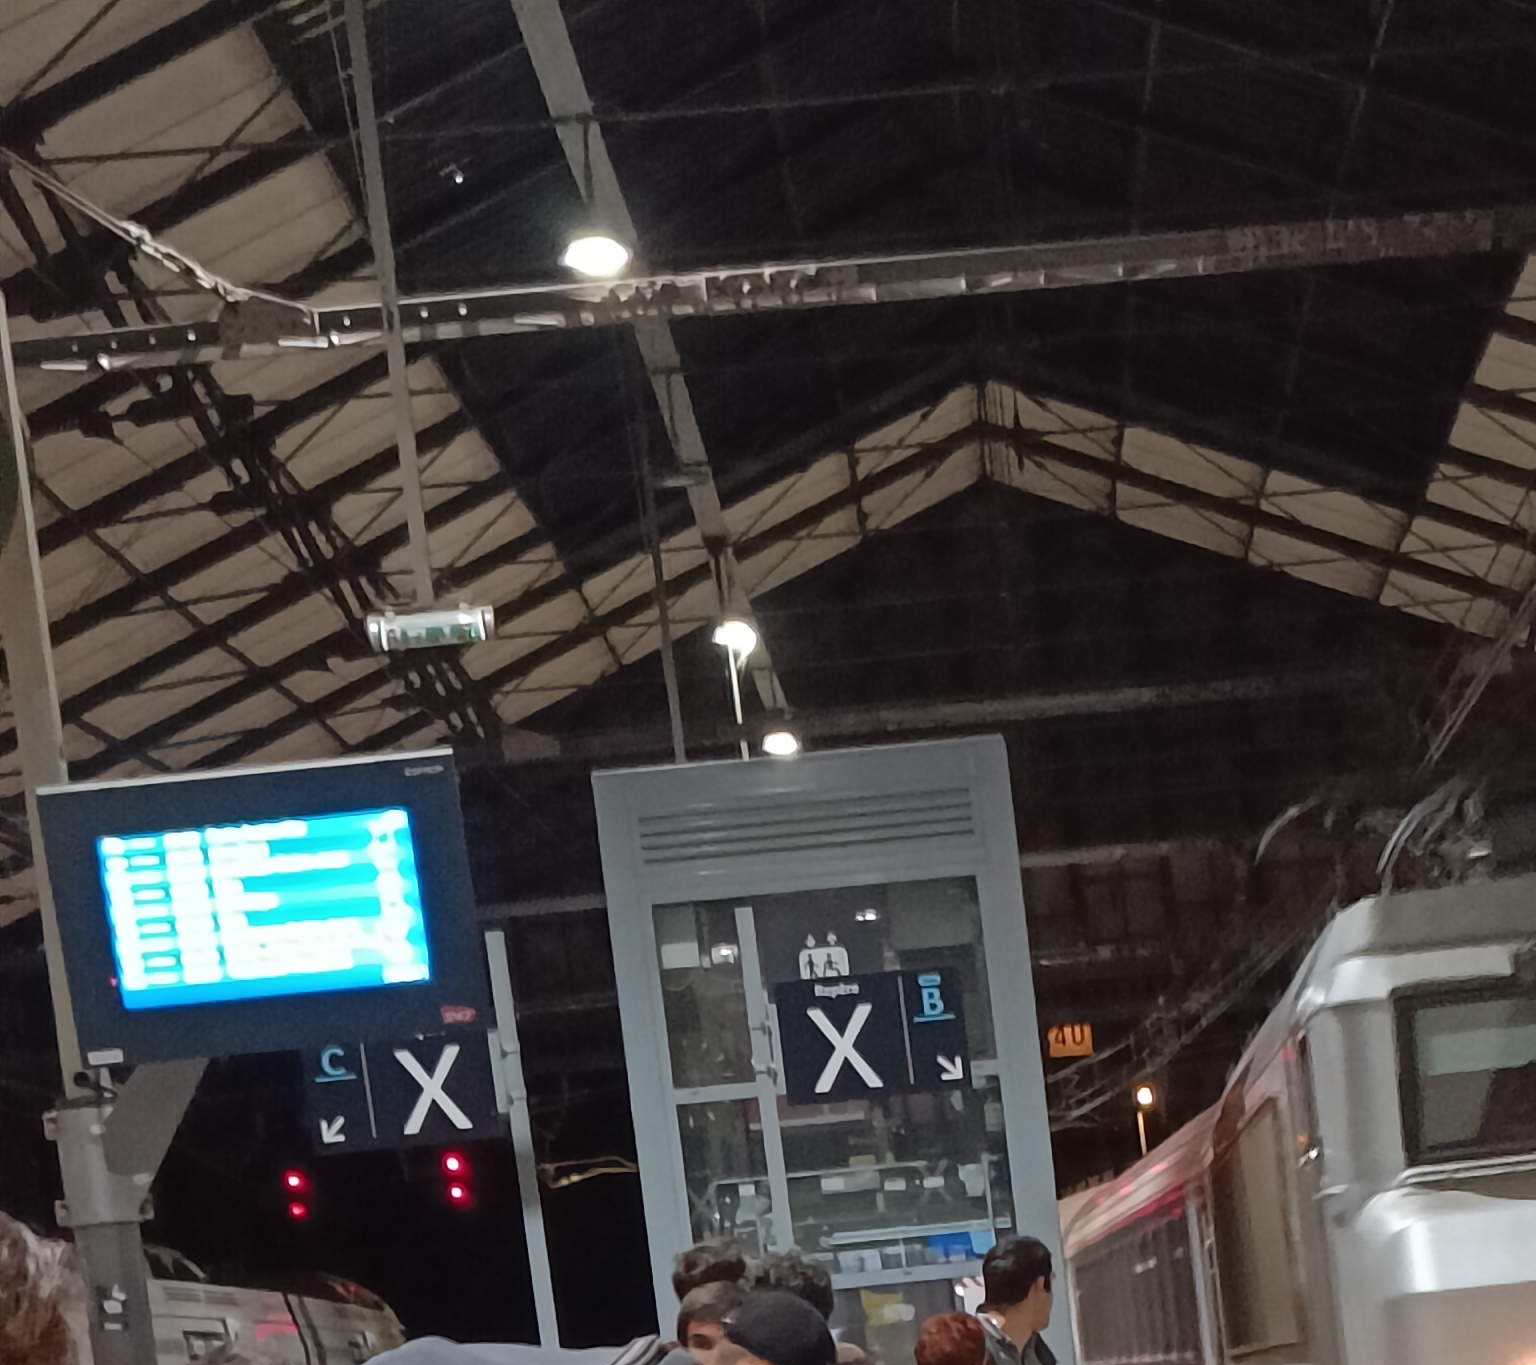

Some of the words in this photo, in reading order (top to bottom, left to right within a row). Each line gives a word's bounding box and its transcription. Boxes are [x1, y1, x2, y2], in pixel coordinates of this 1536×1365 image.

[922, 987, 944, 1015] B
[320, 1046, 347, 1076] C
[806, 1002, 884, 1094] X
[393, 1043, 473, 1135] X
